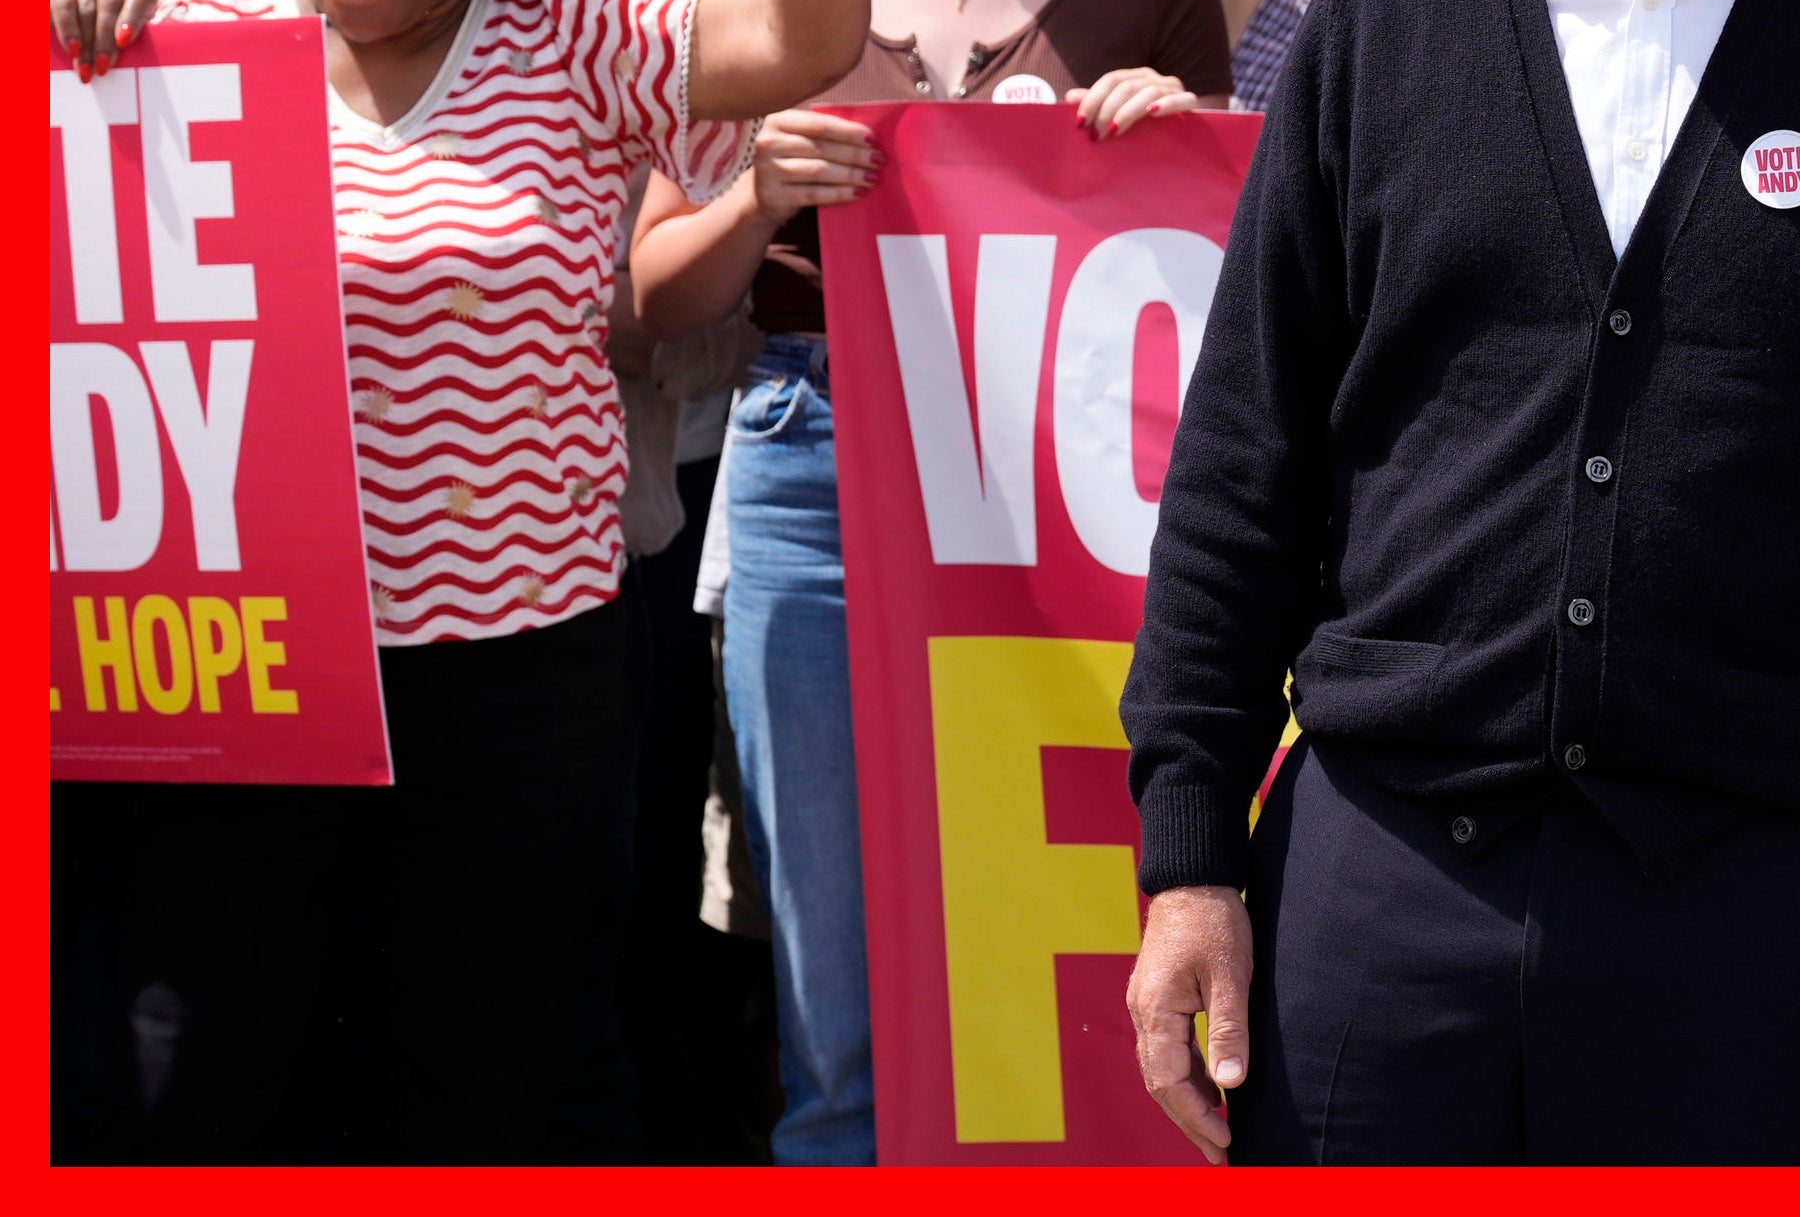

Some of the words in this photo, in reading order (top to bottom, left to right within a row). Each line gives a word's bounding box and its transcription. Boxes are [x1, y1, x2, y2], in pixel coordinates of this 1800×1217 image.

[50, 63, 258, 325] TE
[1004, 86, 1042, 100] VOTE
[50, 339, 255, 573] DY
[876, 227, 1227, 577] VO
[72, 594, 300, 715] HOPE
